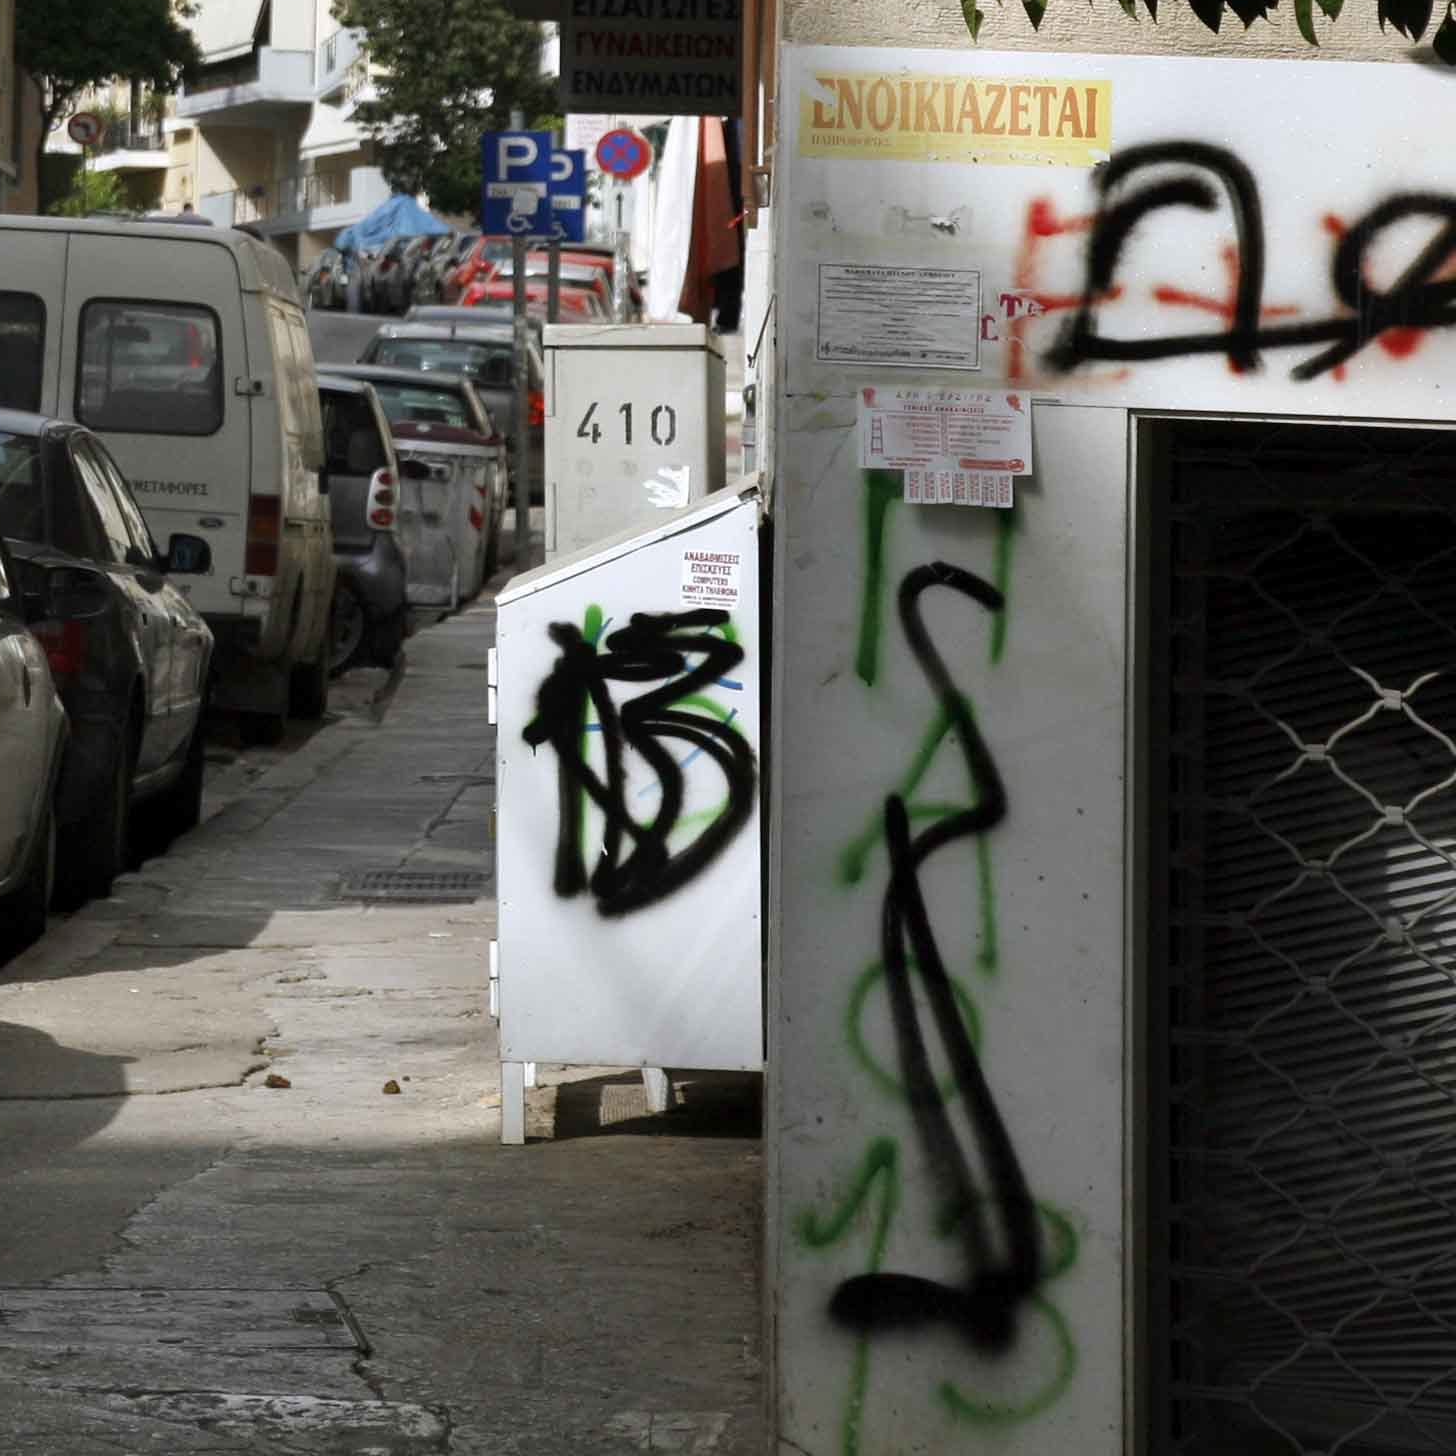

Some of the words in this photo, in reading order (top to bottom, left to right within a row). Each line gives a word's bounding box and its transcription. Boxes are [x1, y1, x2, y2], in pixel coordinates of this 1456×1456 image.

[575, 31, 736, 58] ΓΥΝΑΙΚΕΙΩΝ
[573, 70, 737, 97] ΕΝΔΥΜΑΤΩΝ
[498, 136, 539, 181] P
[576, 401, 677, 446] 410
